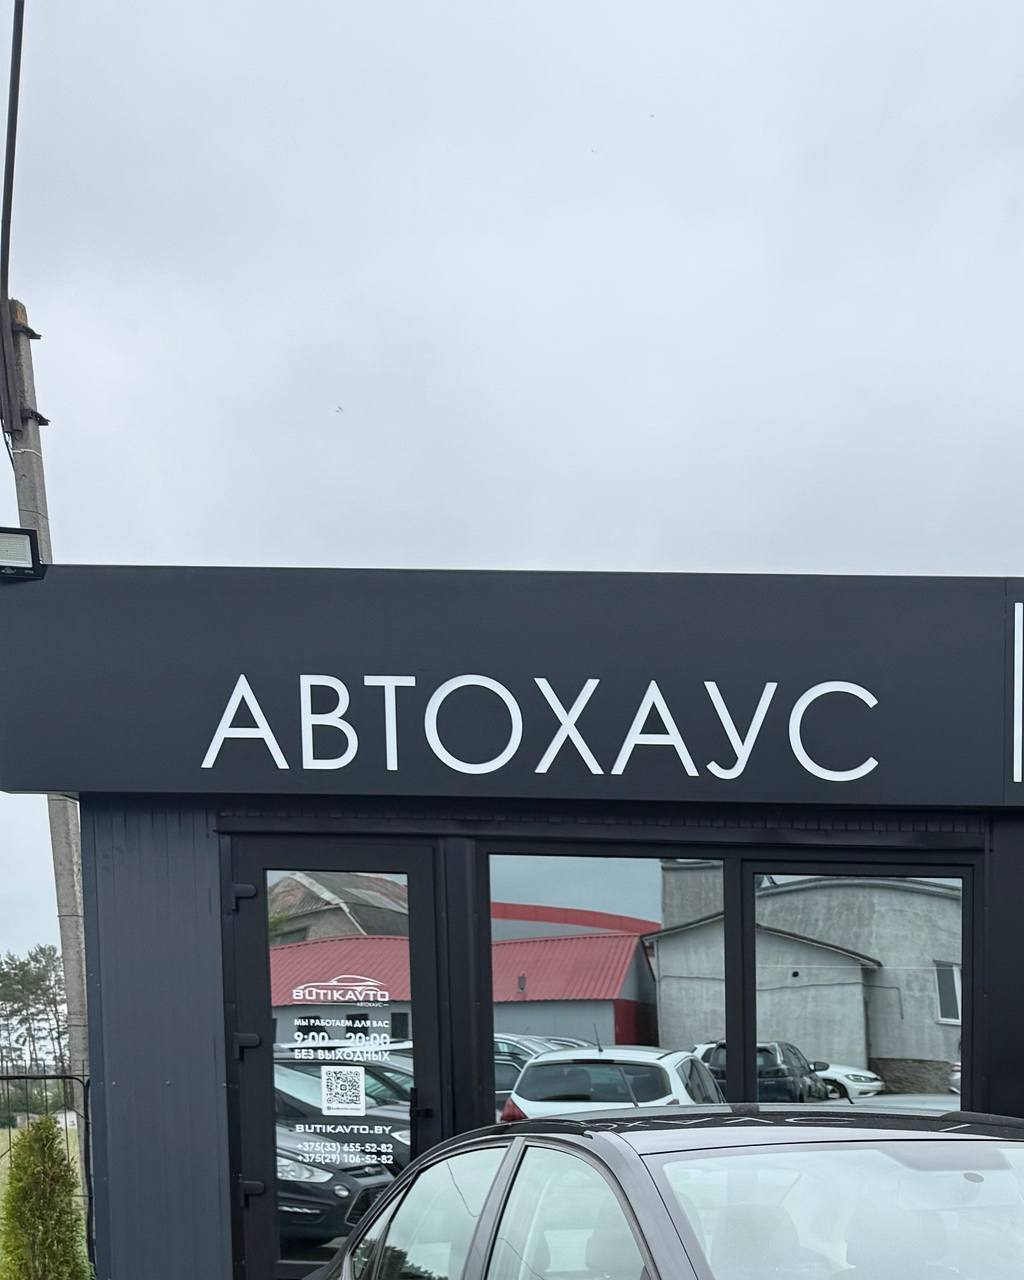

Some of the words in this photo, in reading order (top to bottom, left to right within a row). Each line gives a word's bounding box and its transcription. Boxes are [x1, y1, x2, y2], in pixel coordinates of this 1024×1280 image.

[201, 673, 879, 783] АВТОХАУС
[292, 989, 389, 1001] BUTIKAVTO
[294, 1018, 308, 1026] МЫ
[310, 1018, 352, 1027] РАБОТАЕМ
[354, 1020, 371, 1028] ДЛЯ
[372, 1020, 390, 1028] ВАС
[294, 1031, 329, 1045] 9:00
[345, 1032, 390, 1046] 20:00
[294, 1048, 314, 1059] БЕЗ
[318, 1048, 390, 1061] ВЫХОДНЫХ
[295, 1124, 392, 1134] BUTIKAVTO.BY
[296, 1142, 341, 1154] +375(33)
[343, 1143, 393, 1153] 655-52-82
[297, 1154, 341, 1164] +375(29)
[343, 1154, 393, 1164] 106-52-82
